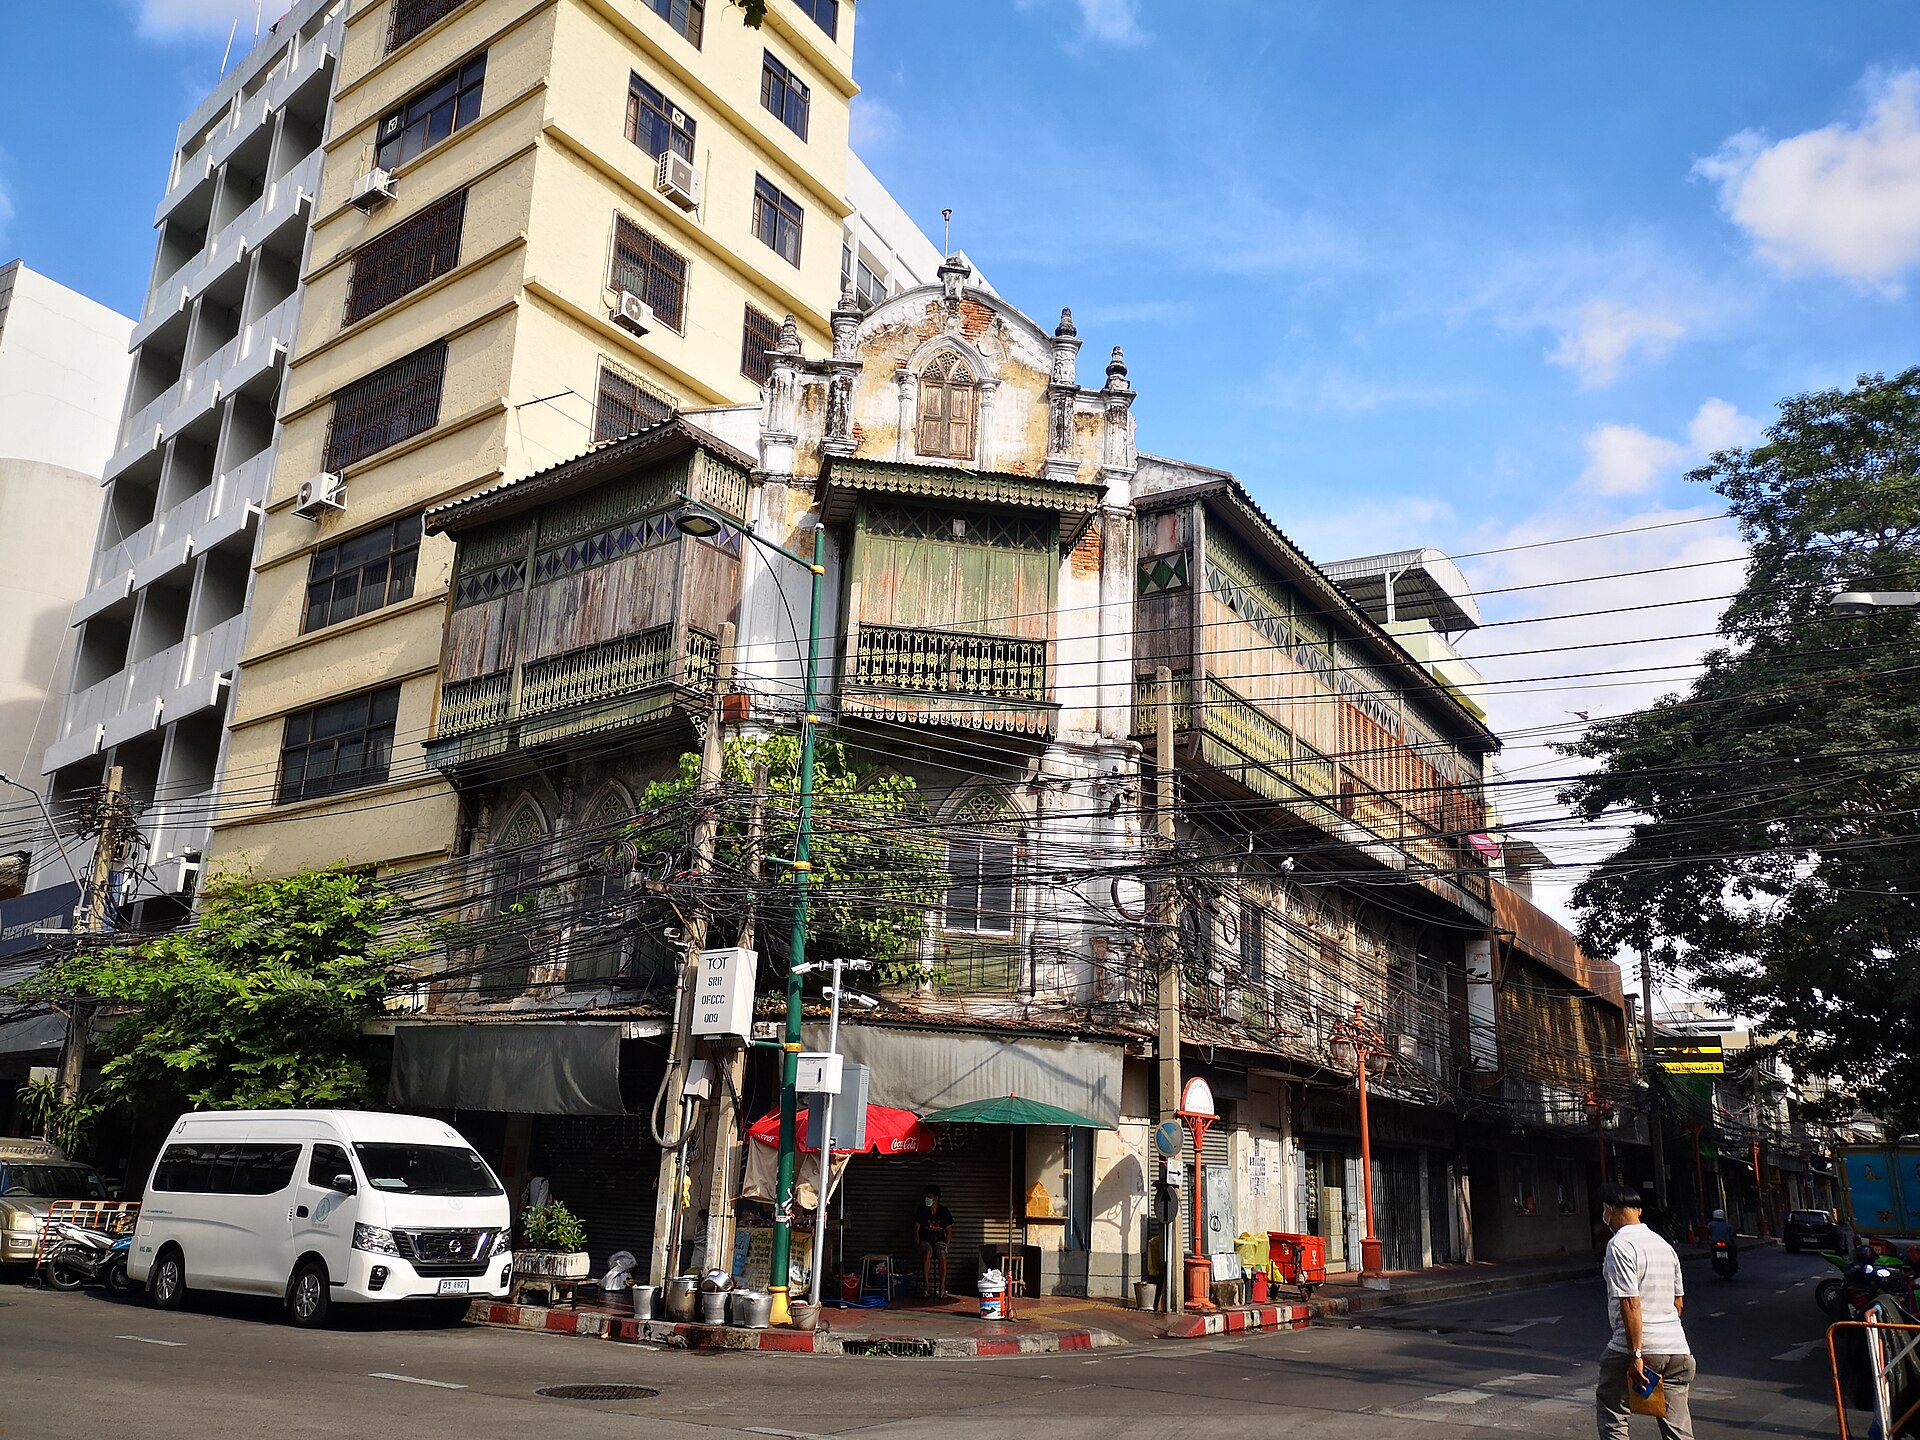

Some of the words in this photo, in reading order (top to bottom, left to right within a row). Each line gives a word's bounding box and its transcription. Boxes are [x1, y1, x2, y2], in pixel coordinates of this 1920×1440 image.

[706, 957, 730, 970] TOT
[707, 976, 722, 986] SRR
[704, 1013, 718, 1023] 009
[175, 1120, 187, 1134] 13
[890, 1136, 919, 1152] Coca-Cola
